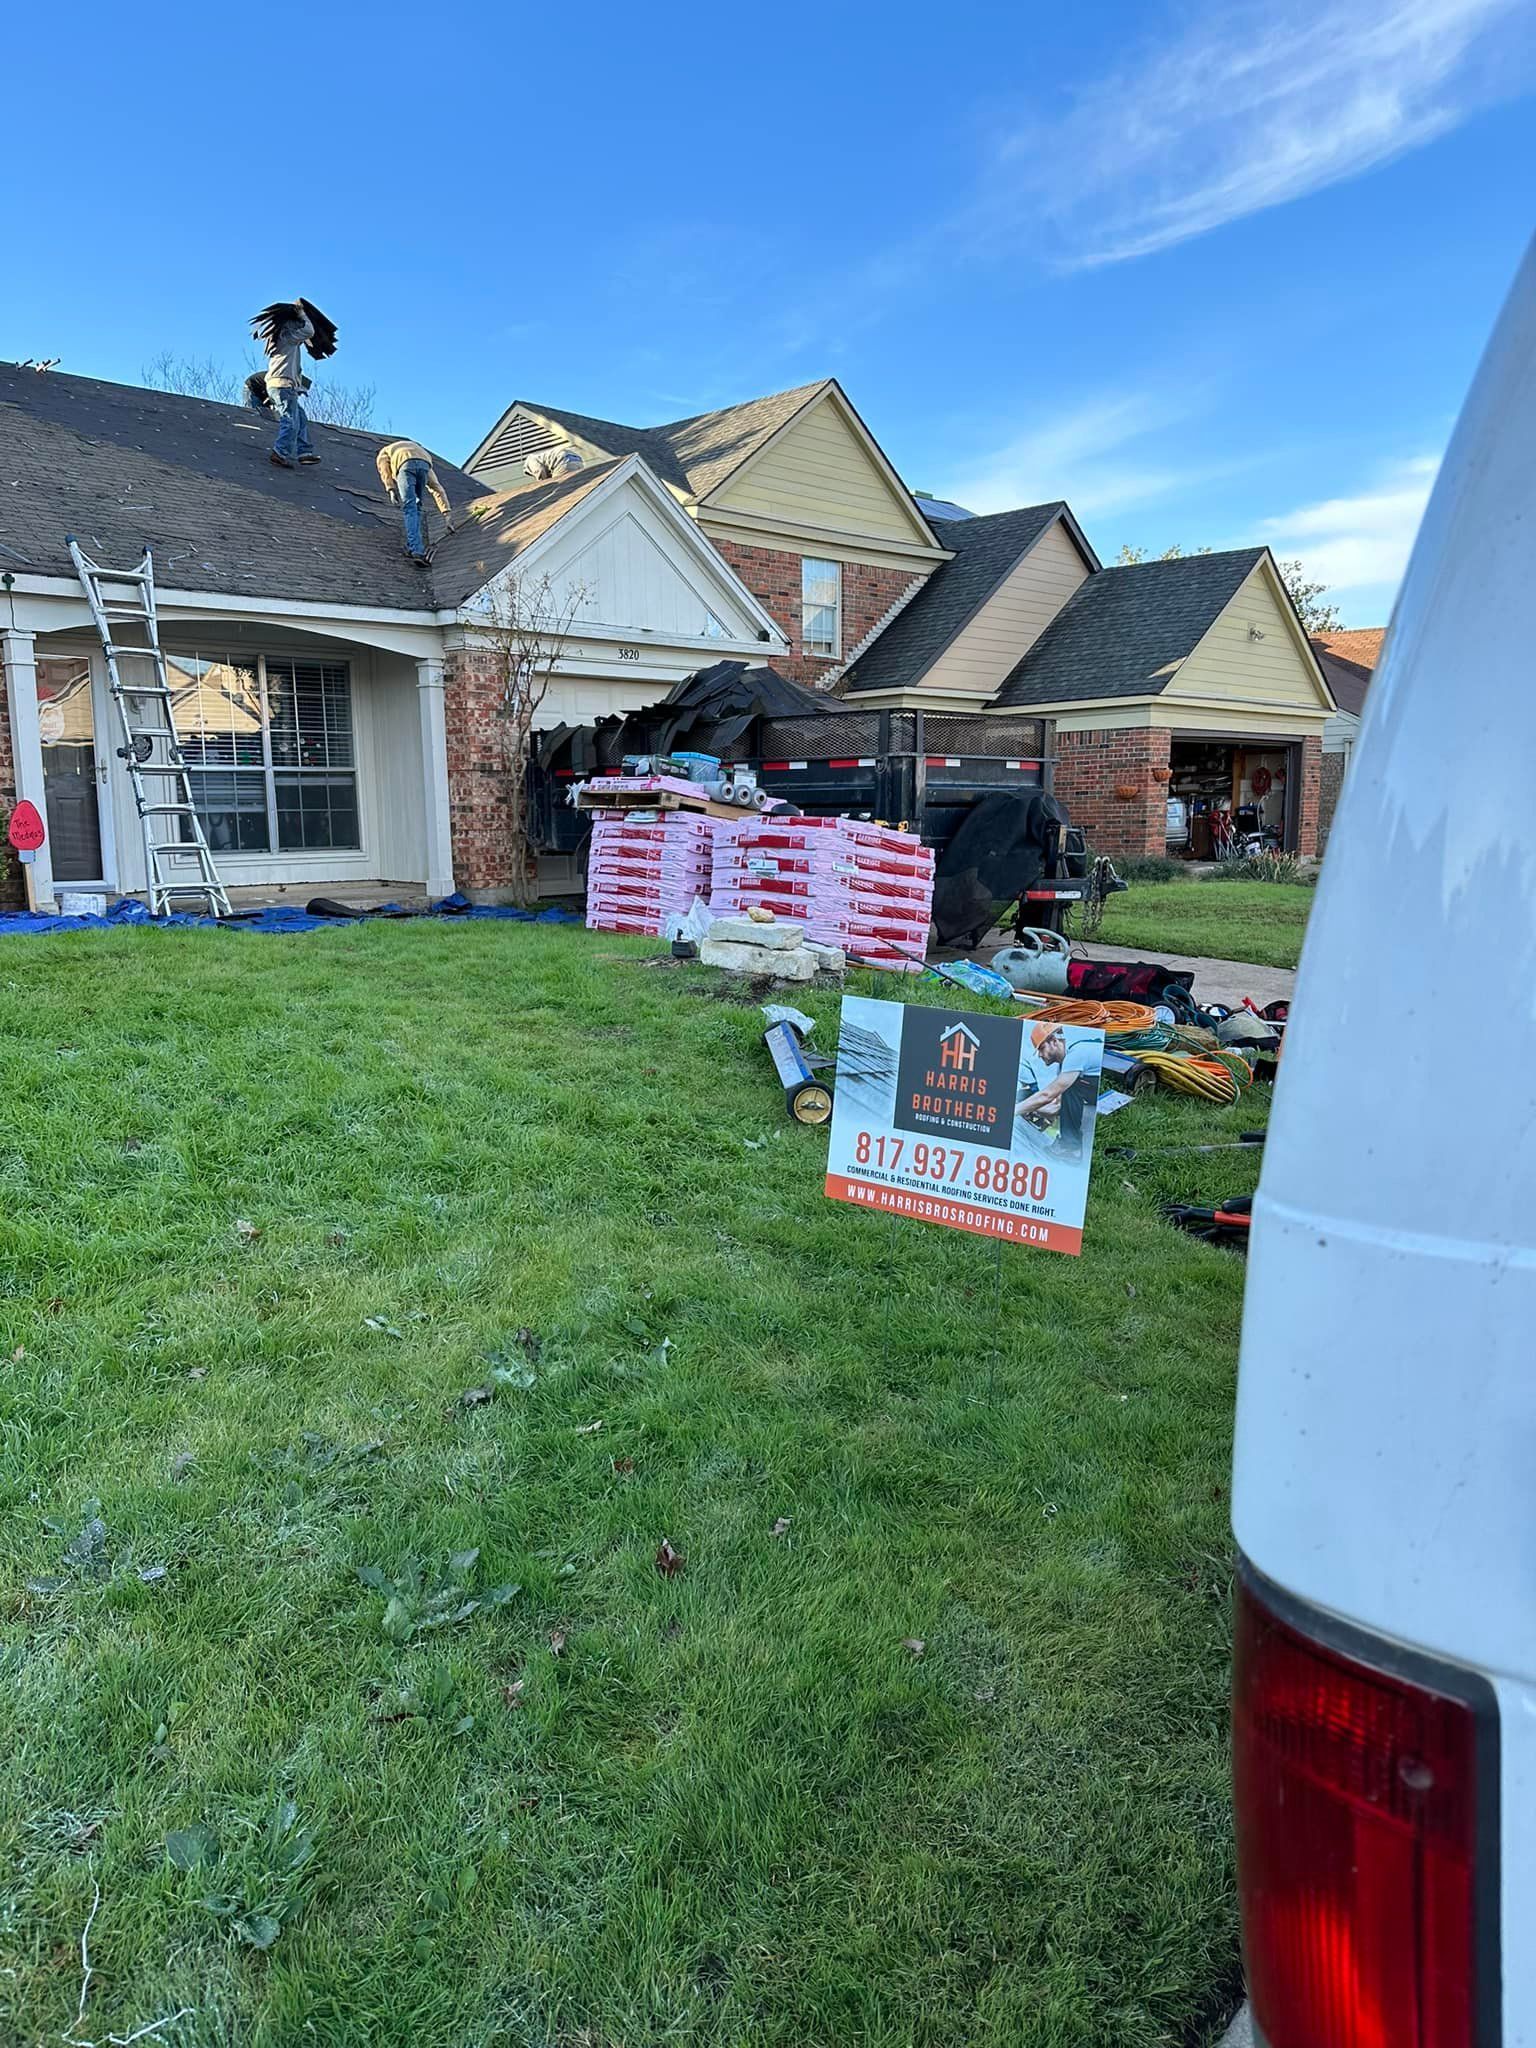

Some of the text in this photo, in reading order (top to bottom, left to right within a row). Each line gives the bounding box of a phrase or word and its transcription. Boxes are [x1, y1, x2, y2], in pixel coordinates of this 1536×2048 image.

[618, 648, 640, 660] 3820
[926, 1070, 987, 1096] HARRIS
[912, 1093, 997, 1123] BROTHERS
[915, 1112, 992, 1134] ROOFING & CONSTRUCTION
[856, 1131, 1049, 1201] 817.937.8880
[847, 1164, 1057, 1218] COMMERCIAL & RESIDENTIAL ROOFING SERVICES DONE RIGHT.
[847, 1183, 1049, 1243] WWW.HARRISBROSROOFING.COM
